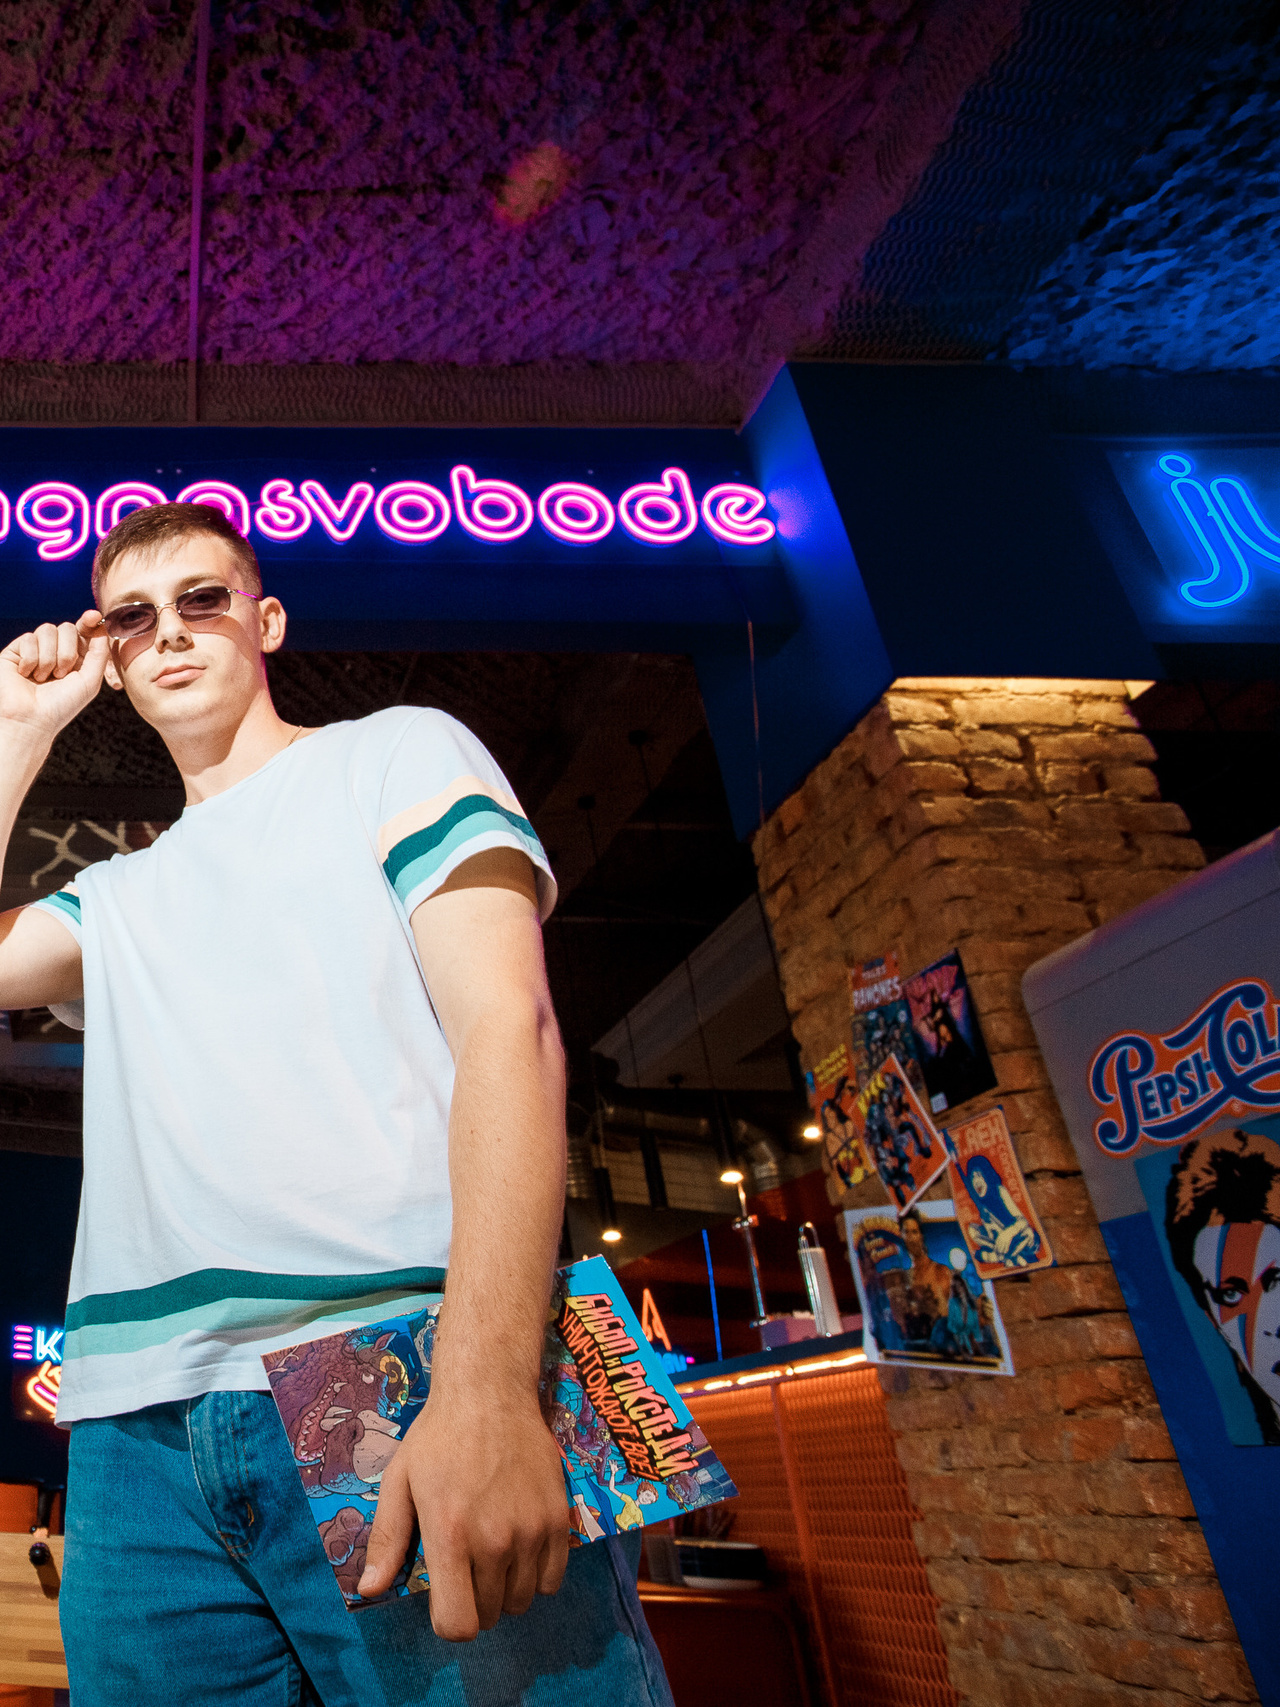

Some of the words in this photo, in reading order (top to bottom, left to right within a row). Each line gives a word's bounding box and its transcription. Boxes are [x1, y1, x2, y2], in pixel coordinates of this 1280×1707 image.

[558, 1304, 640, 1438] УНИЧТОЖАЮТ
[564, 1293, 639, 1358] БИБОП
[606, 1360, 699, 1478] РОКСТЕДИ
